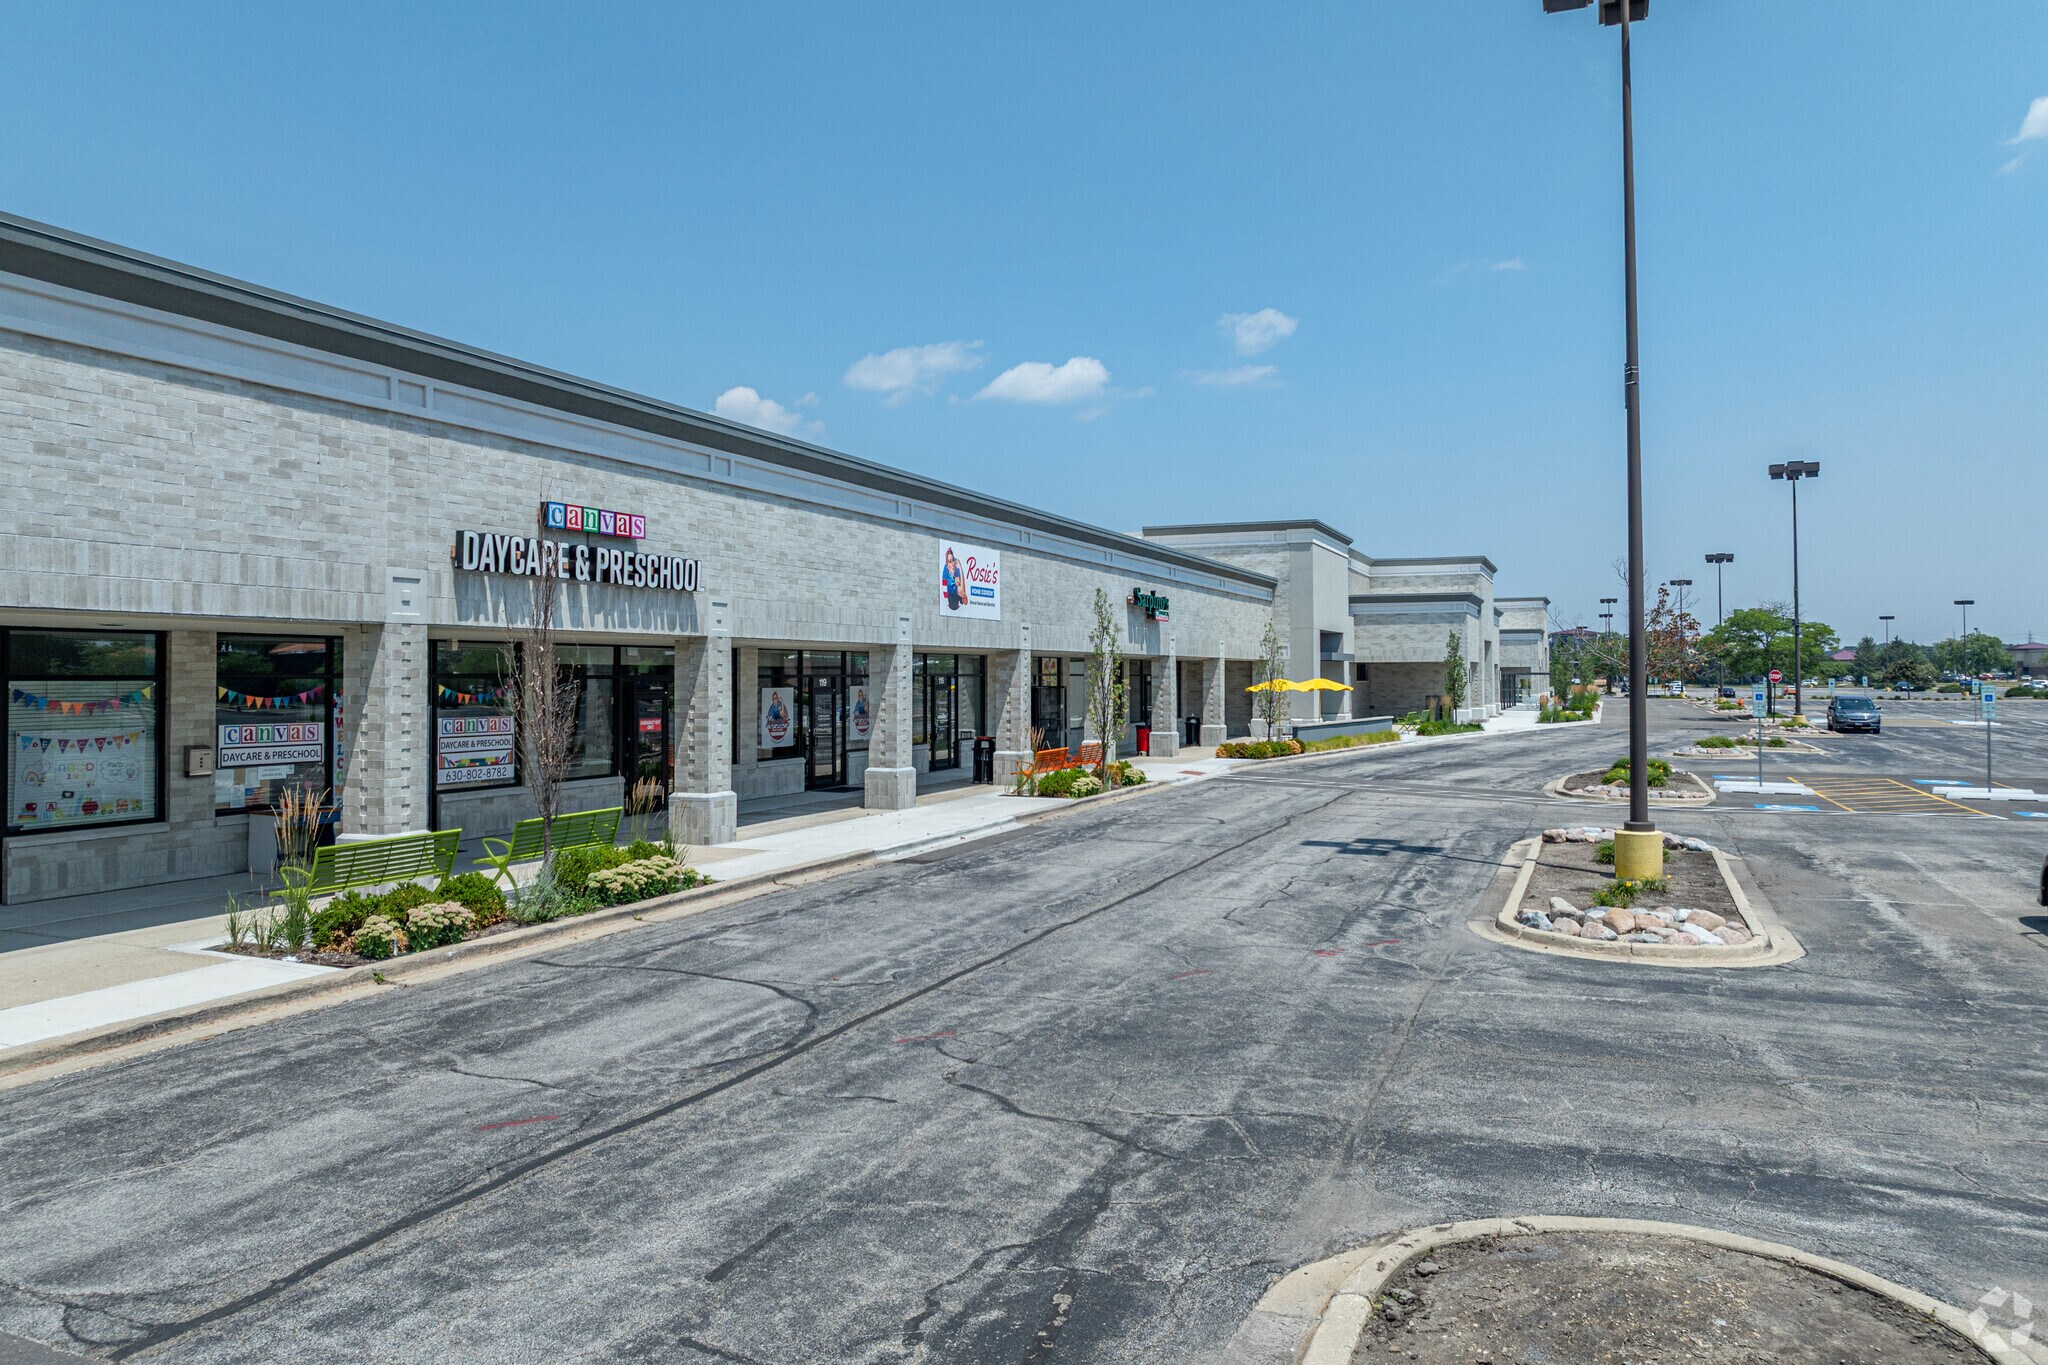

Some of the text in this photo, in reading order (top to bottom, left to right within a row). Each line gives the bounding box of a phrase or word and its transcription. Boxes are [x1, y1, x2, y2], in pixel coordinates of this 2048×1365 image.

[550, 504, 644, 536] canvas
[462, 530, 705, 592] DAYCARE & PRESCHOOL
[966, 556, 998, 584] Rosie's
[443, 718, 508, 733] canvas
[226, 726, 316, 743] canvas
[441, 738, 512, 750] DAYCARE & PRESCHOOL
[222, 749, 320, 763] DAYCARE & PRESCHOOL
[445, 766, 507, 782] 630-802-8782
